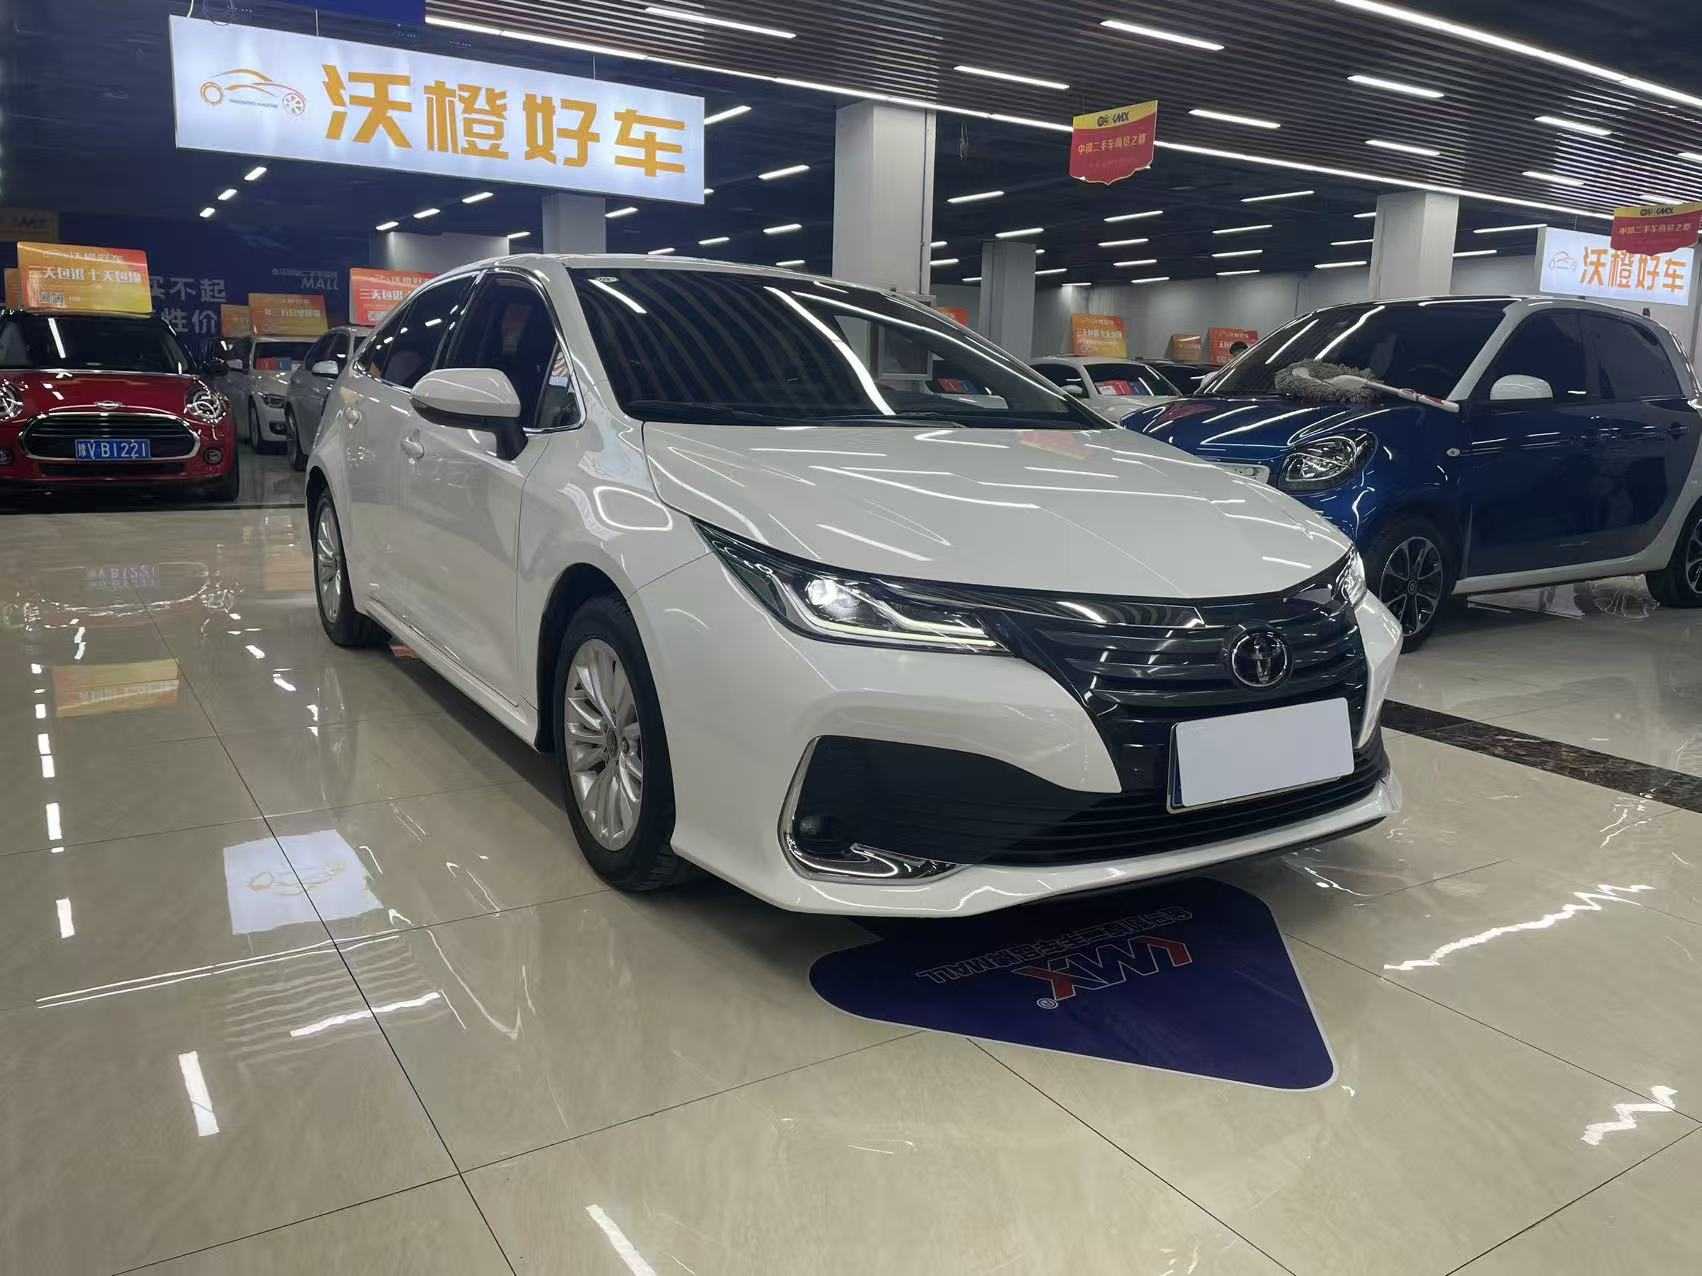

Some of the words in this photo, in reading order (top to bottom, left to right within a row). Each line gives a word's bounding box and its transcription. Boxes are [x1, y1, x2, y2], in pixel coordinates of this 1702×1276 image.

[321, 64, 686, 178] 沃橙好车
[1579, 246, 1687, 293] 沃橙好车
